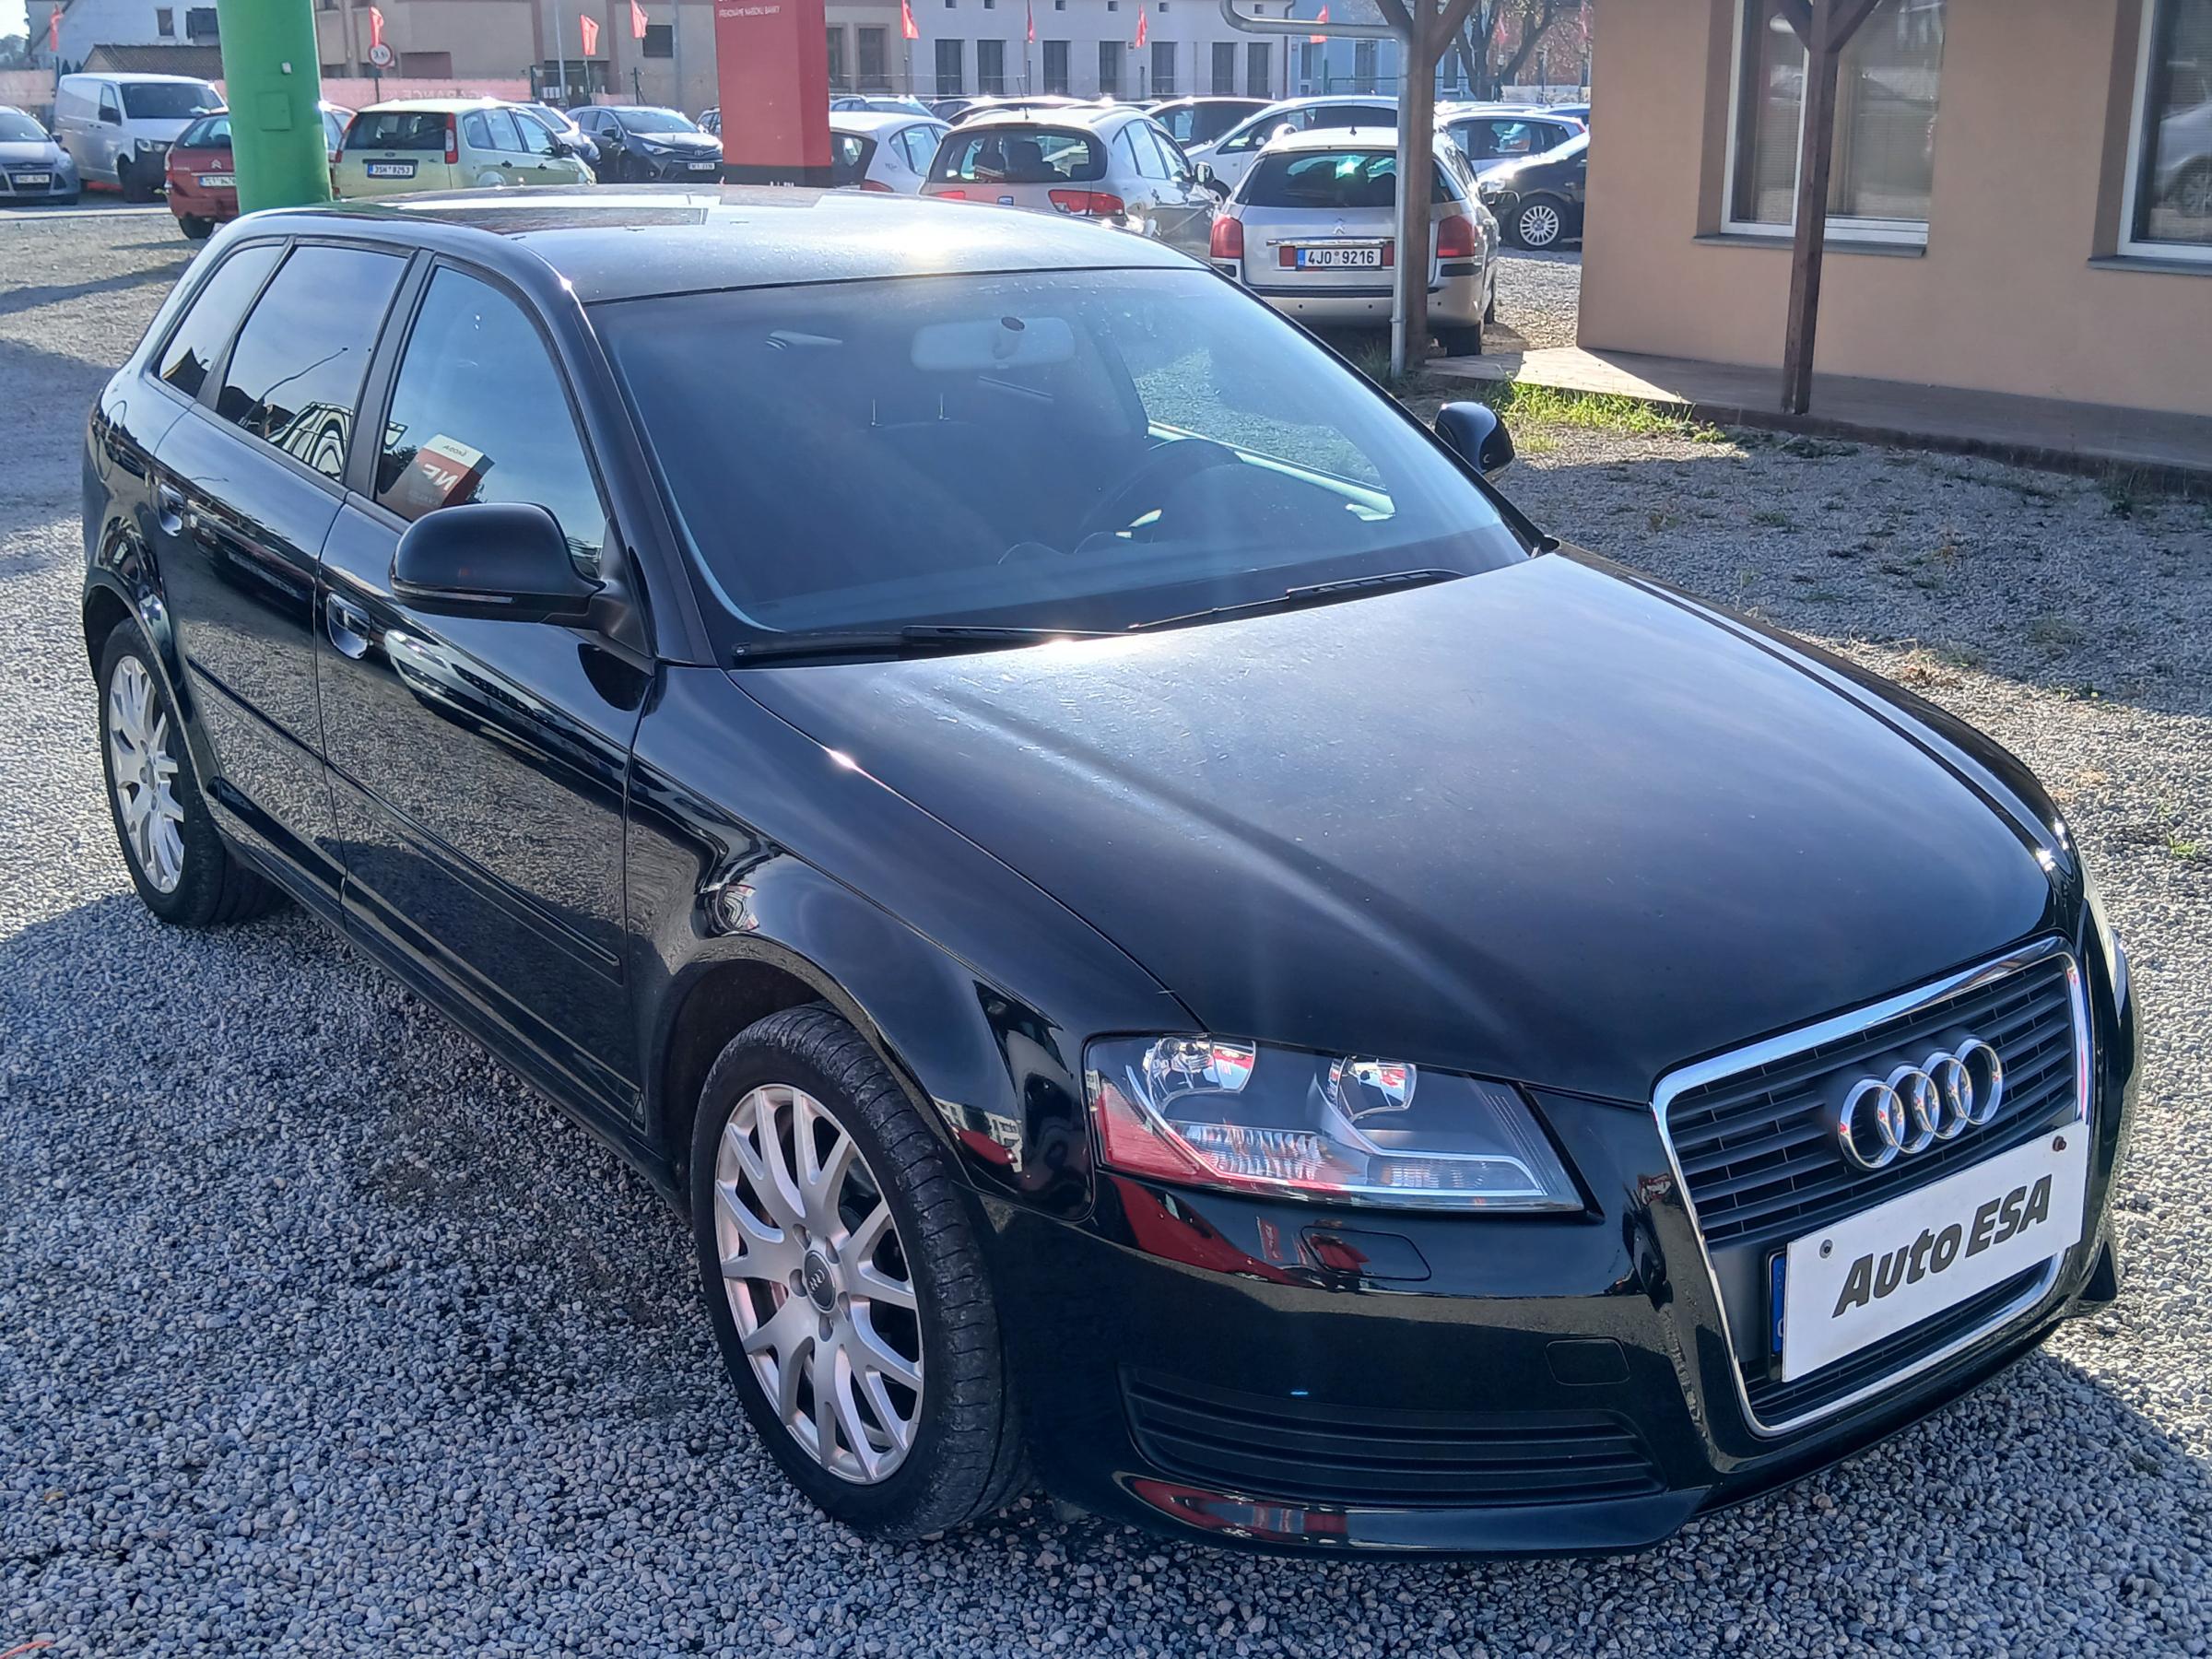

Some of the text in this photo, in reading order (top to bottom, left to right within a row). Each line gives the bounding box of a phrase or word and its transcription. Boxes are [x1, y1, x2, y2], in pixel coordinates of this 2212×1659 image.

[1341, 251, 1374, 265] 9216
[1831, 1173, 2053, 1319] Auto ESA
